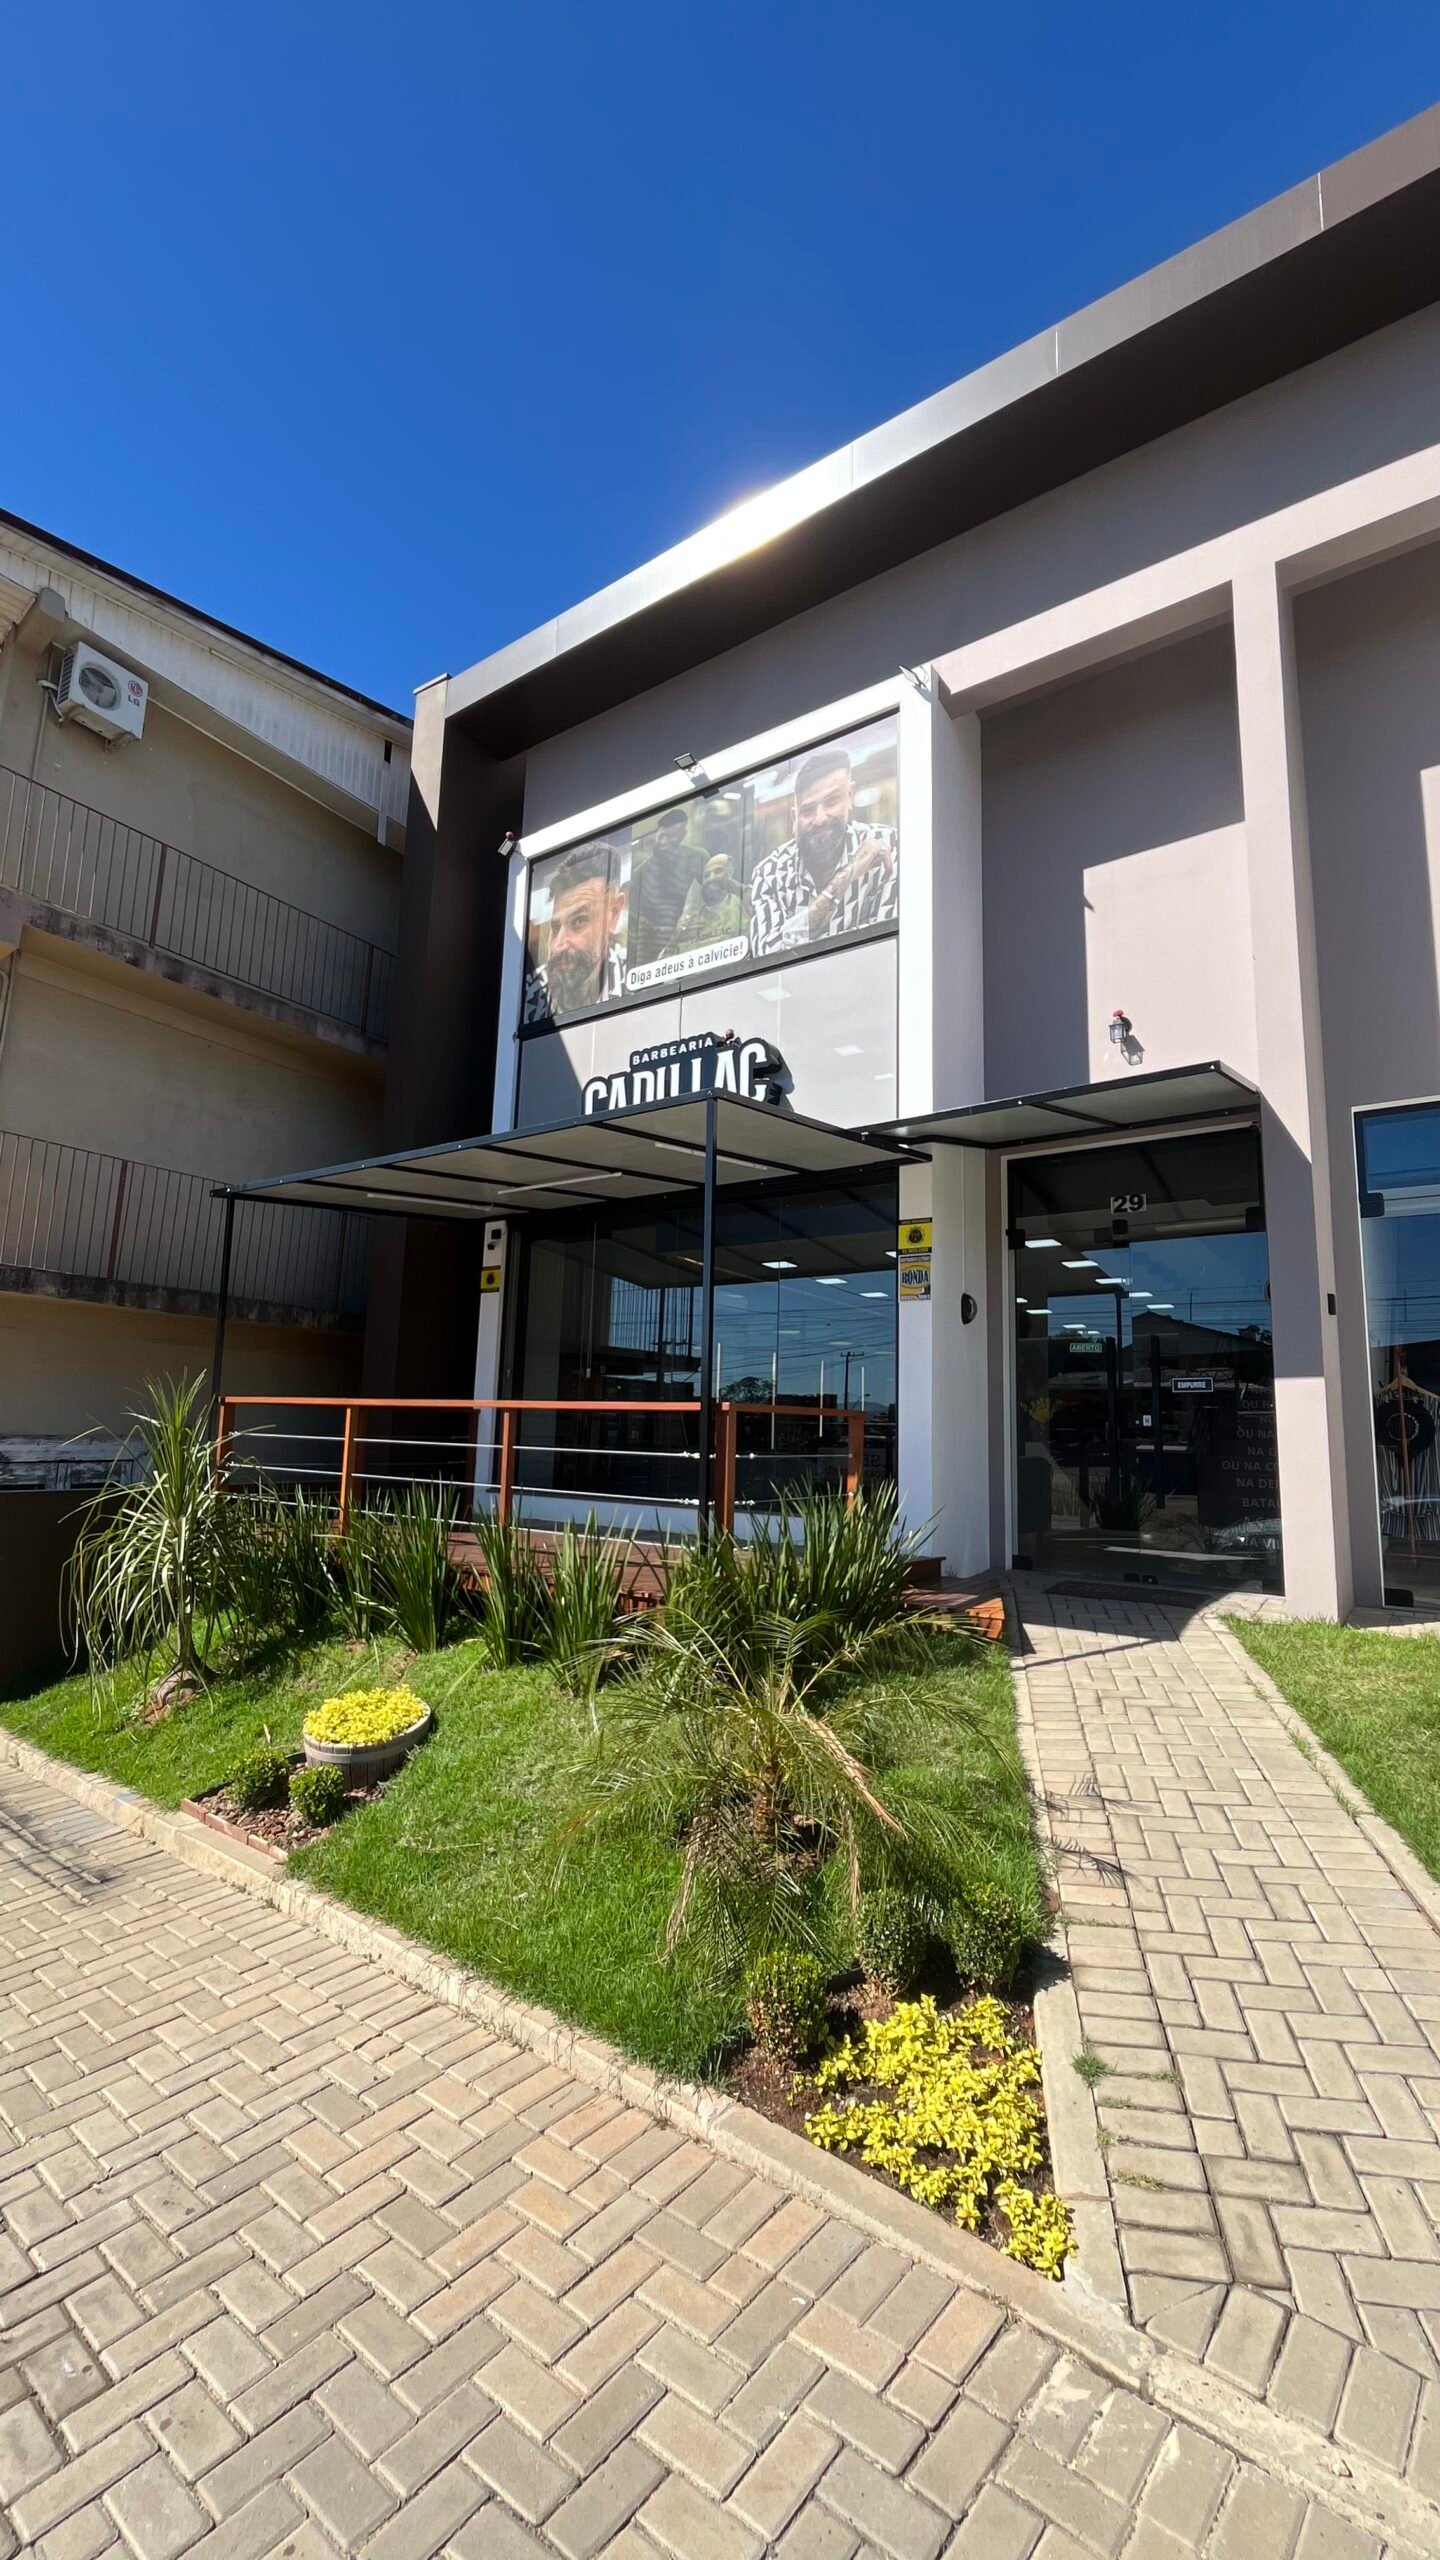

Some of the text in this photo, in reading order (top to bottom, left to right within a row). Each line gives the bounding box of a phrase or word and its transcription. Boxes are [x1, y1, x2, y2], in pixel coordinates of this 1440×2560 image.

[128, 694, 140, 707] LG
[631, 941, 743, 985] Diga adeus à calvicie!
[632, 1036, 713, 1066] BARBEARIA
[584, 1042, 769, 1116] CADILLAC
[1113, 1194, 1145, 1213] 29
[901, 1269, 929, 1285] RONDA
[1071, 1343, 1101, 1351] ABERTO
[1177, 1381, 1207, 1389] EMPURRE
[1222, 1460, 1240, 1470] OU
[1243, 1461, 1262, 1471] NA
[1236, 1478, 1255, 1488] NA
